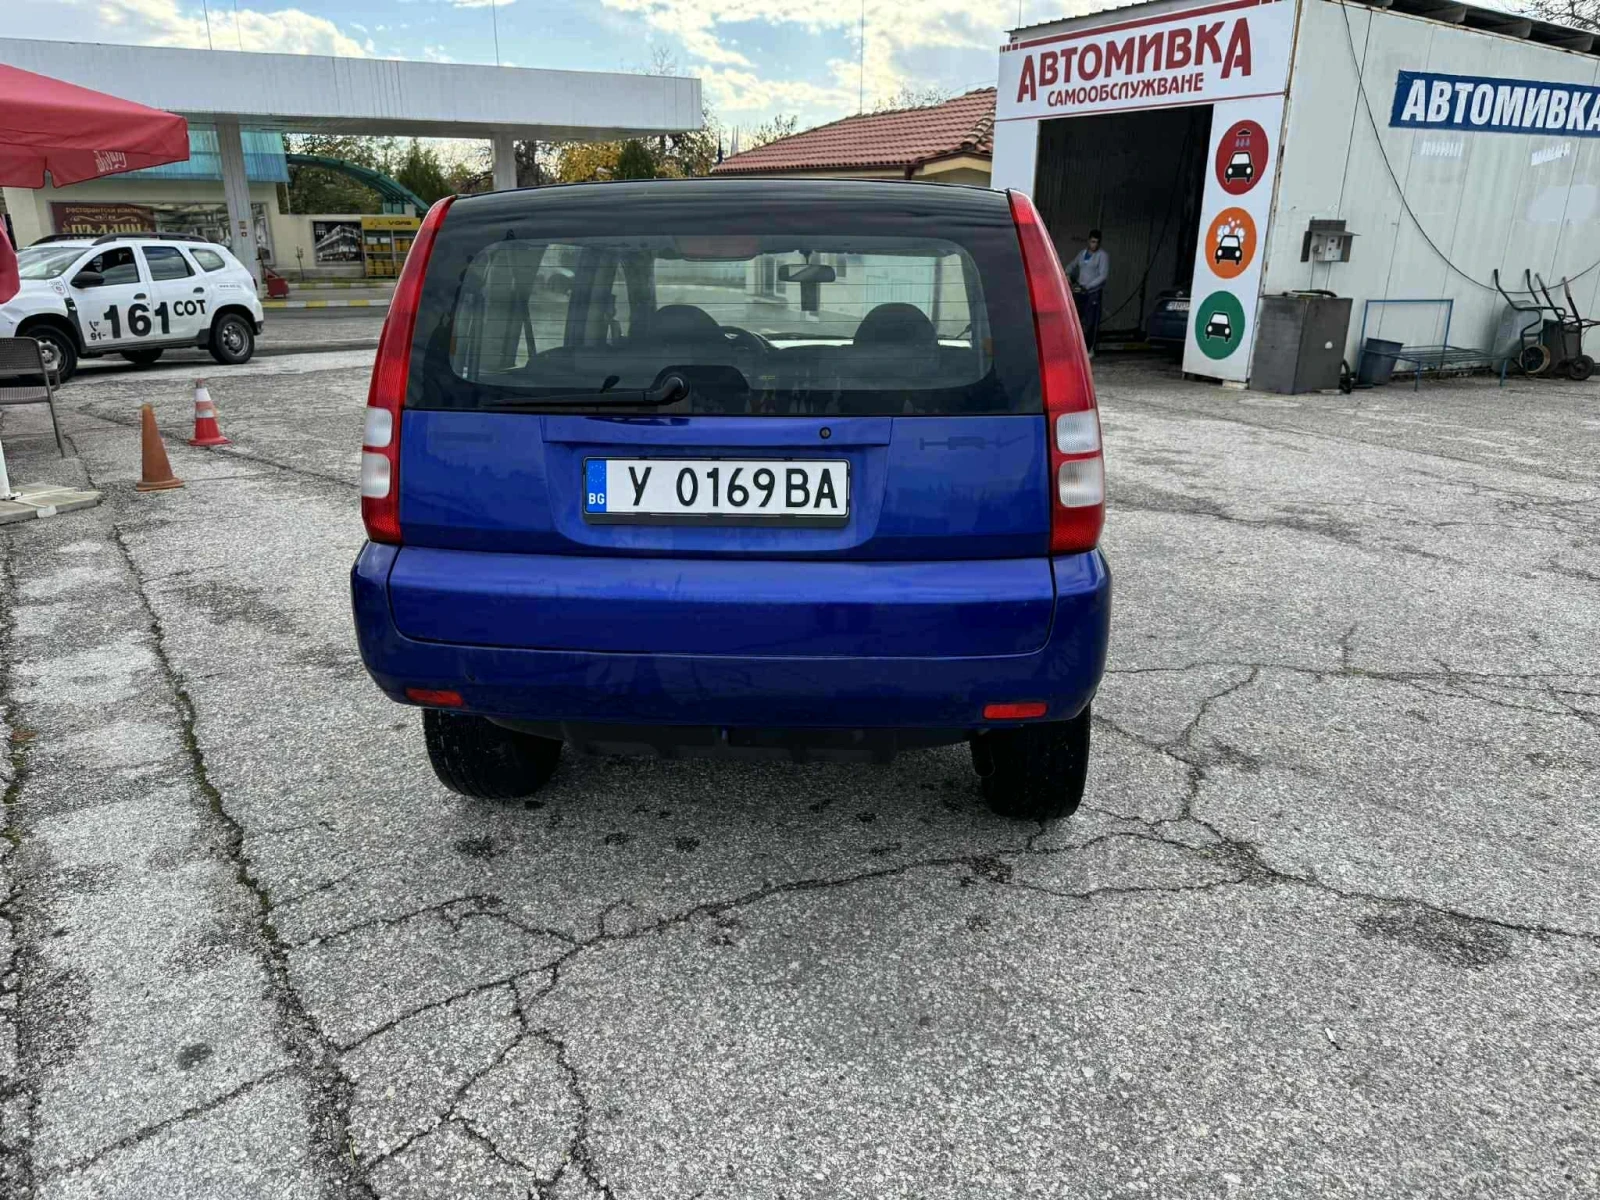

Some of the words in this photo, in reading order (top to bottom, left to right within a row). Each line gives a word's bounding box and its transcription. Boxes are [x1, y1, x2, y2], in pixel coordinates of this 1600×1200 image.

[1017, 17, 1251, 103] АВТОМИВКА
[1047, 73, 1204, 107] САМООБСЛУЖВАНЕ
[1401, 79, 1600, 131] АВТОМИВКА
[104, 301, 171, 338] 161
[173, 299, 206, 316] СОТ
[588, 493, 605, 505] BG
